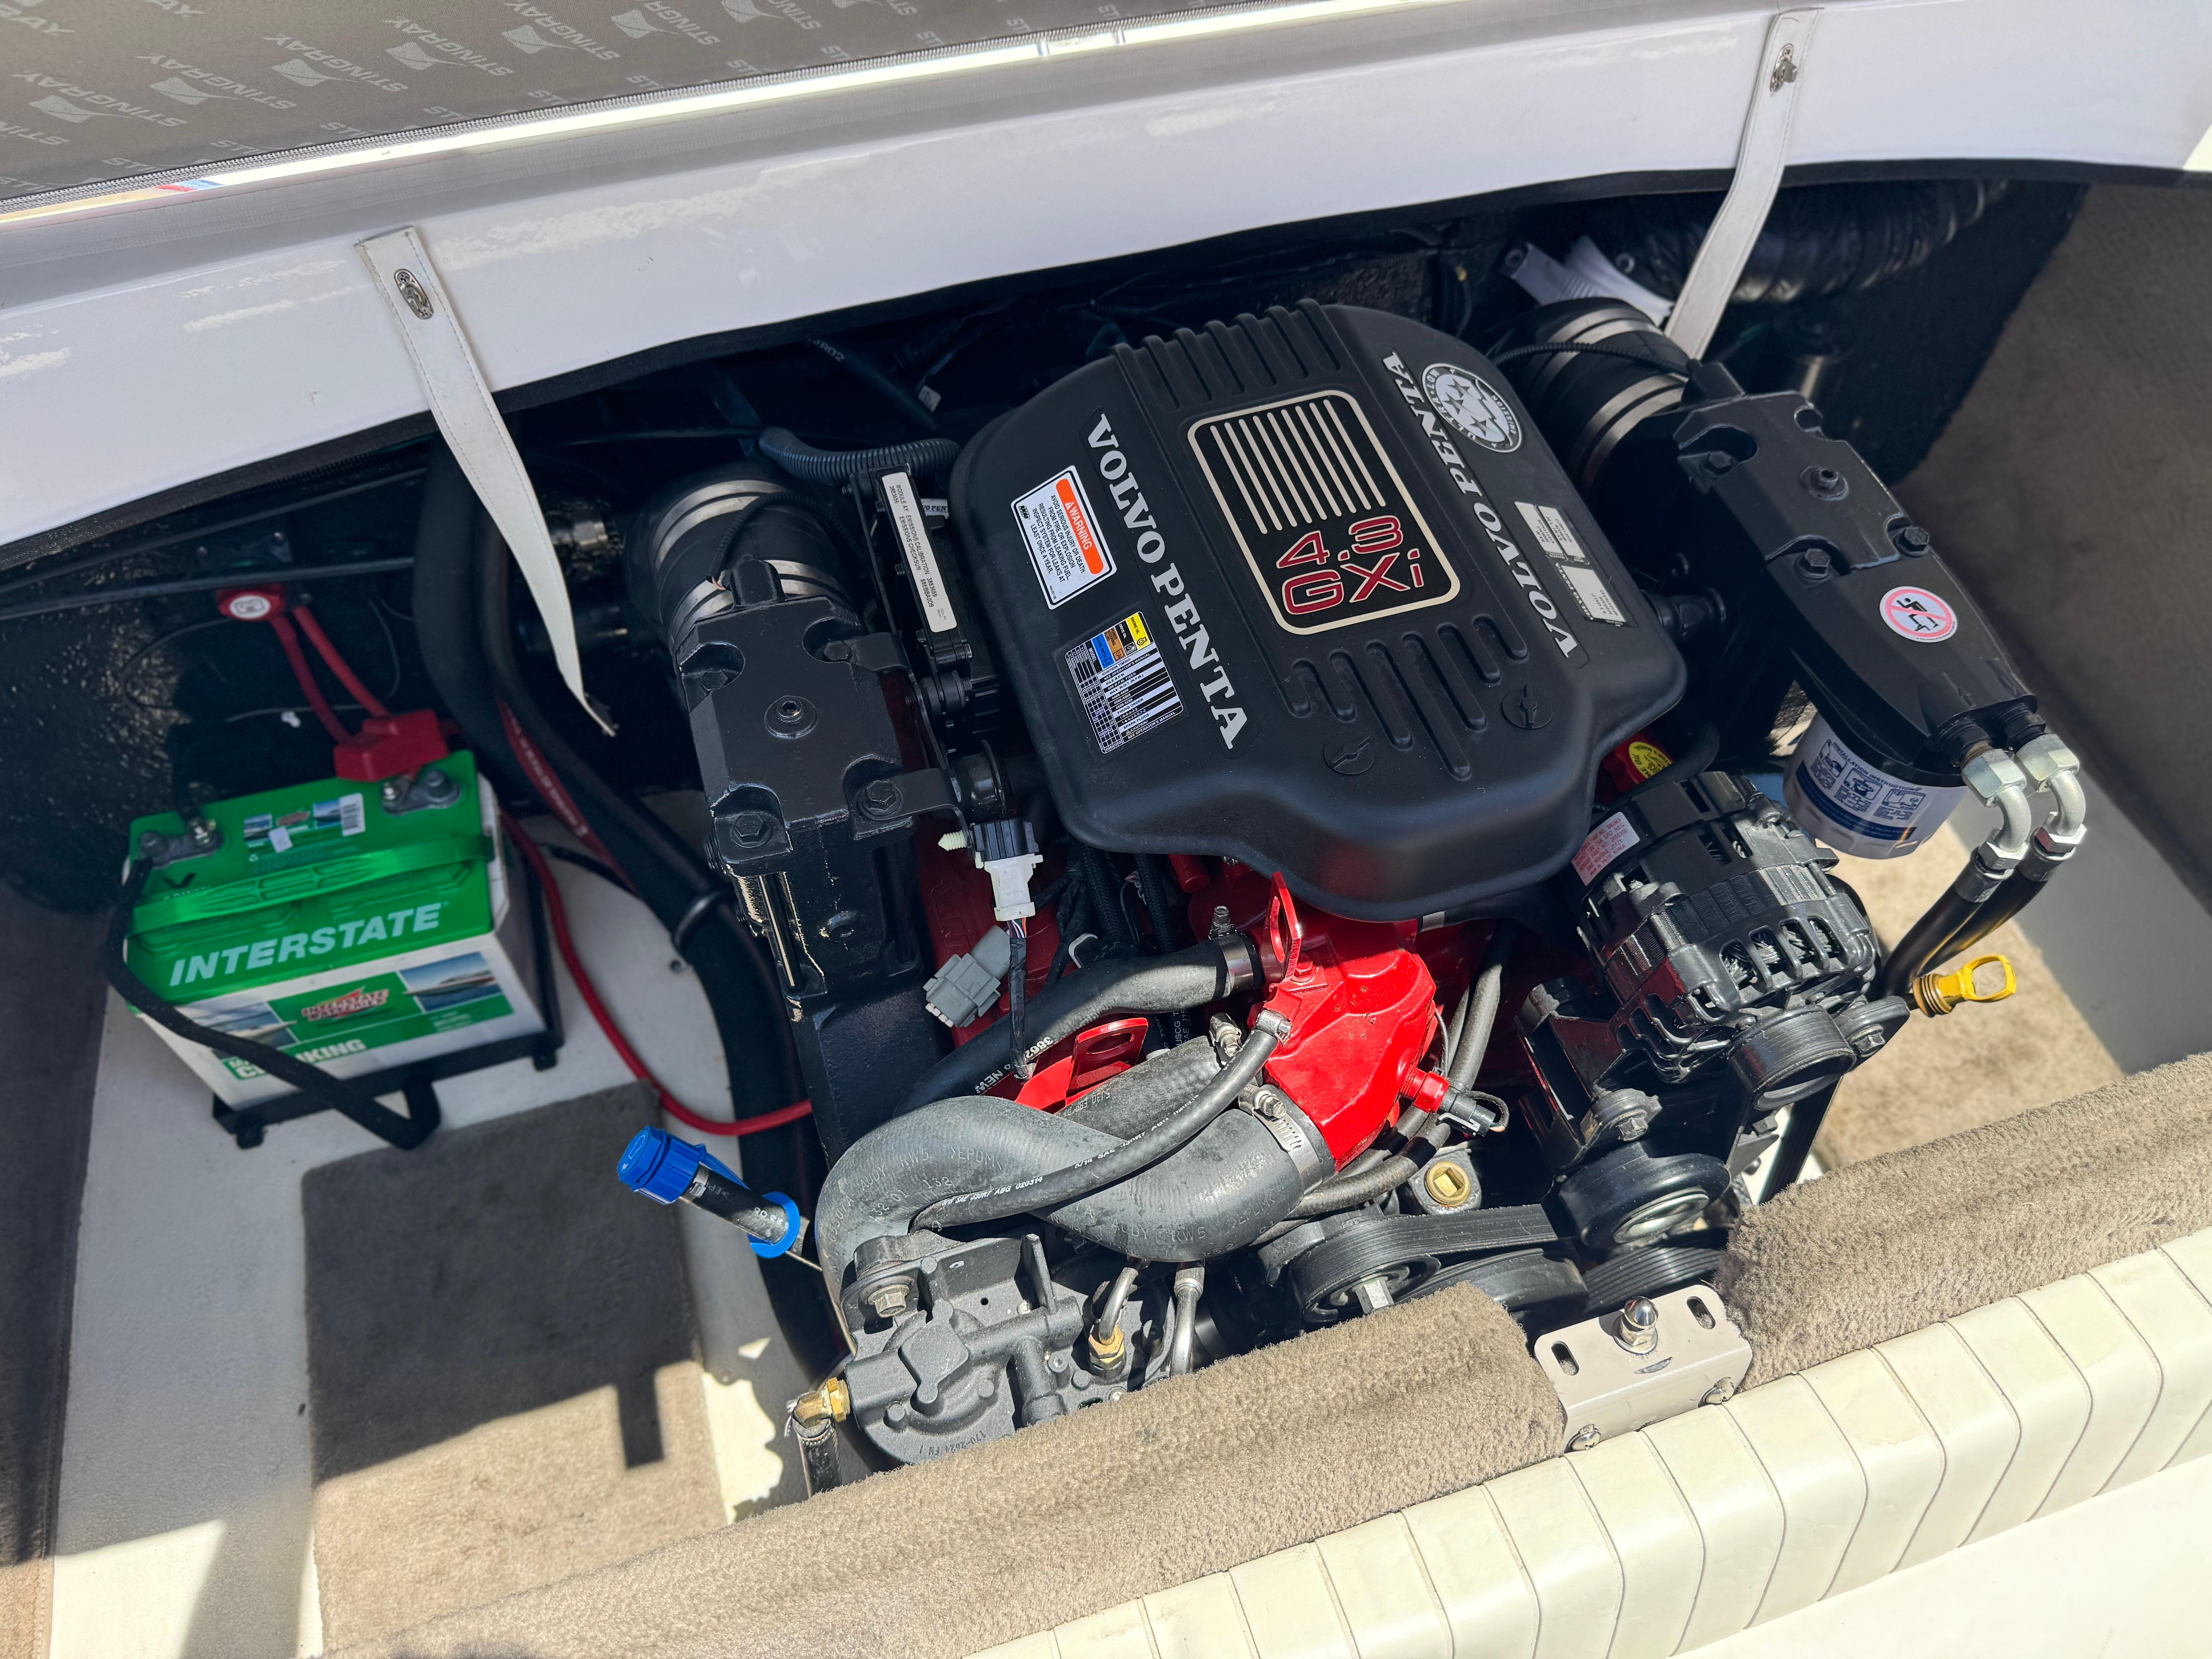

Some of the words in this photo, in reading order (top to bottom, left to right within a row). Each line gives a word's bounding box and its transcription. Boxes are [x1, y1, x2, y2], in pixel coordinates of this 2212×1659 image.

[383, 16, 513, 76] STINGRAY
[503, 0, 620, 60] STINGRAY
[643, 0, 720, 46] STINGR
[136, 53, 297, 110] STINGRAY
[263, 33, 408, 92] STINGRAY
[12, 70, 187, 127] STINGRAY
[1382, 351, 1483, 495] PENTA
[1491, 395, 1516, 434] EMISSION
[895, 484, 906, 504] MODULE
[902, 504, 908, 512] AY
[905, 515, 918, 541] EMISSIONS
[914, 541, 929, 575] CALIBRATION
[926, 577, 937, 598] 3883659
[899, 515, 912, 543] EMISSIONS
[908, 542, 921, 571] CHECKSUM
[1030, 524, 1040, 540] LEAST
[1037, 540, 1045, 554] ONCE
[1044, 558, 1053, 574] YEAR.
[1032, 508, 1044, 528] INSPECT
[1040, 528, 1051, 548] SYSTEM
[1053, 558, 1062, 575] LEAKS
[1038, 503, 1051, 530] RESULTING
[1049, 529, 1058, 544] FROM
[1054, 543, 1066, 565] LEAKING
[1063, 565, 1072, 580] FUEL.
[1047, 507, 1056, 521] FROM
[1058, 532, 1064, 540] OR
[1061, 540, 1075, 568] EXPLOSION
[1050, 495, 1060, 510] AVOID
[1056, 509, 1068, 531] SERIOUS
[1065, 530, 1075, 548] INJURY
[1073, 548, 1079, 556] OR
[1076, 556, 1085, 573] DEATH
[1068, 506, 1092, 550] WARNING
[1276, 514, 1404, 569] 4.3
[1087, 413, 1165, 564] VOLVO
[1152, 563, 1247, 749] PENTA
[1282, 548, 1424, 615] GXi
[1474, 502, 1579, 659] VOLVO
[1554, 562, 1574, 591] PENTA
[1572, 591, 1593, 621] VOLVO
[1088, 647, 1097, 663] MODEL
[1102, 665, 1118, 676] IGNITION
[1118, 658, 1130, 666] TIMING
[1135, 653, 1150, 663] MANUAL
[1159, 710, 1176, 722] MANUAL
[1832, 742, 1870, 776] INSTALLATION
[1603, 830, 1613, 839] GRD
[1613, 823, 1624, 831] NEG
[169, 902, 443, 986] INTERSTATE
[1014, 1176, 1044, 1190] 020314
